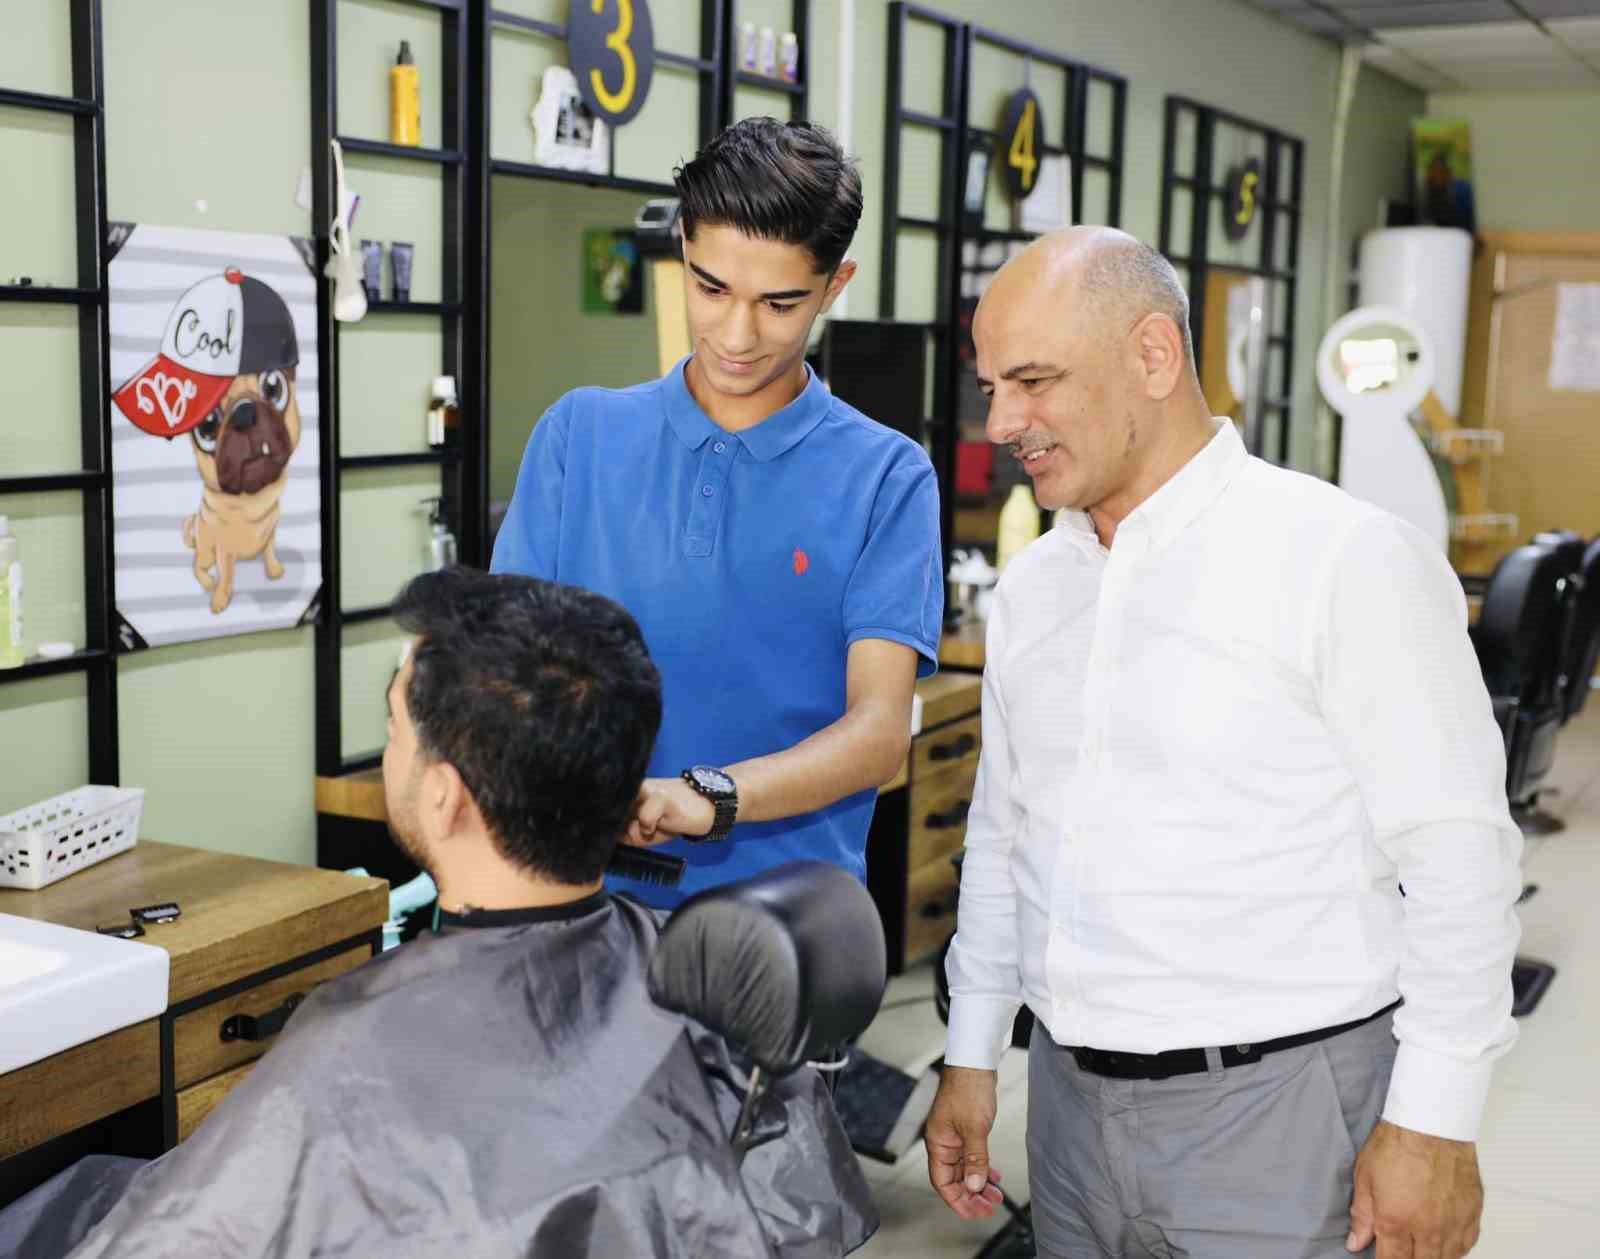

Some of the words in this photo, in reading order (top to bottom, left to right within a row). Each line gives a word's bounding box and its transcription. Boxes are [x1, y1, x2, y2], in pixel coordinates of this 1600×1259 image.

[590, 0, 636, 112] 3
[1008, 99, 1036, 191] 4
[1236, 172, 1258, 224] 5
[175, 309, 234, 358] Cool
